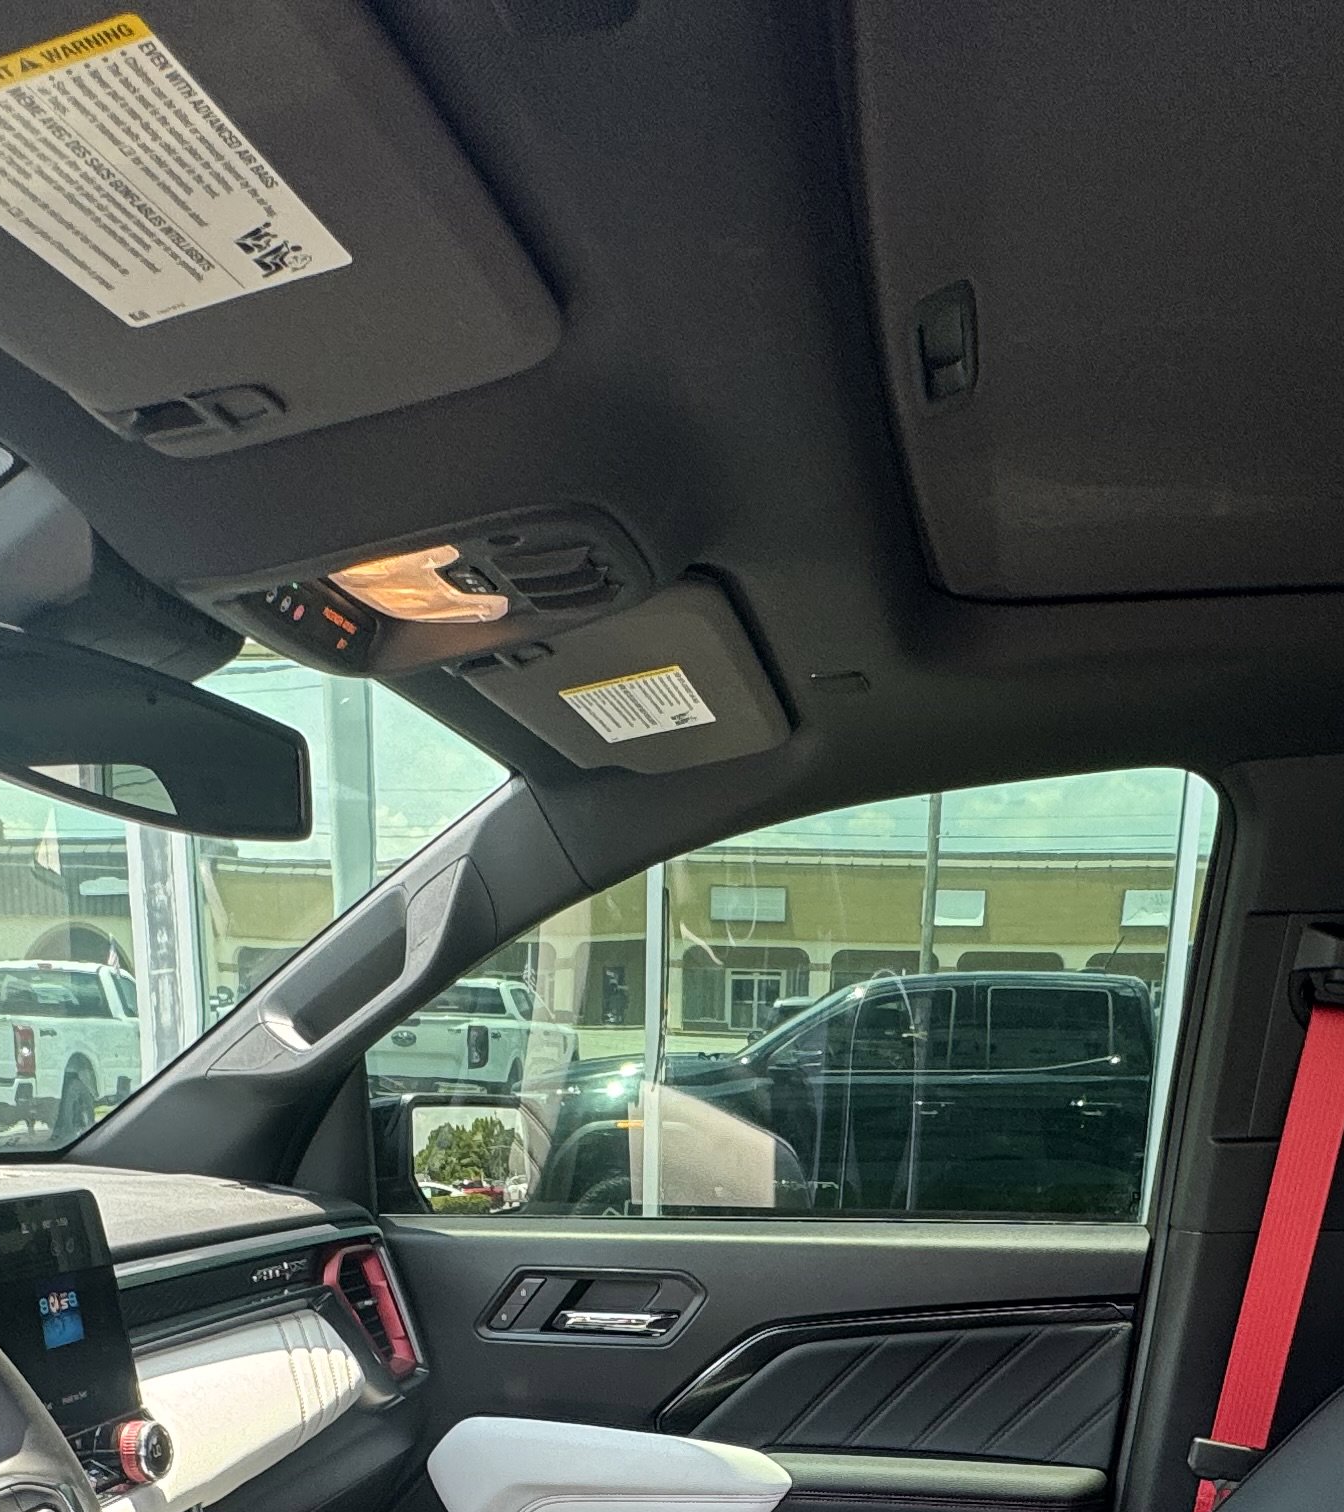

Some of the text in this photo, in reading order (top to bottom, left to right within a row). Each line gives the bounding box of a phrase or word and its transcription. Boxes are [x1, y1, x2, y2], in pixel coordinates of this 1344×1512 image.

[39, 23, 135, 64] WARNING
[137, 41, 279, 189] EVEN WITH ADVANCED AIR BAGS
[64, 139, 92, 158] DES
